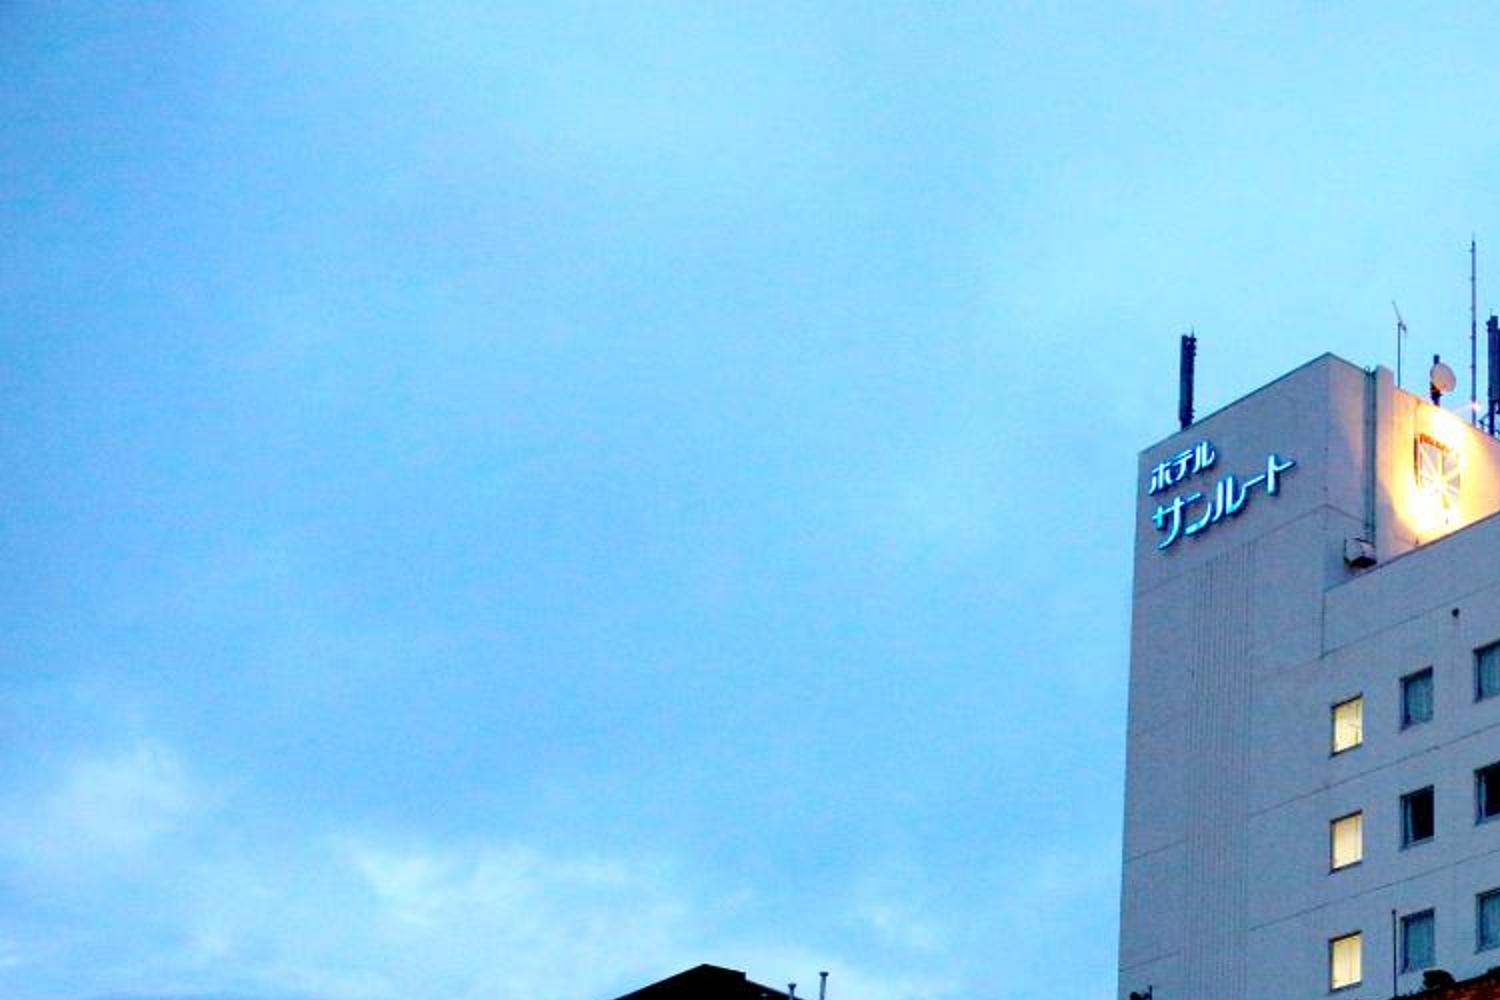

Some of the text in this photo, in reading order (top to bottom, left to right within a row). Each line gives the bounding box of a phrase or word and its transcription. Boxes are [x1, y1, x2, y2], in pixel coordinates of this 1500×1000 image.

[1149, 440, 1216, 495] ホテル
[1152, 454, 1297, 551] サンルート
